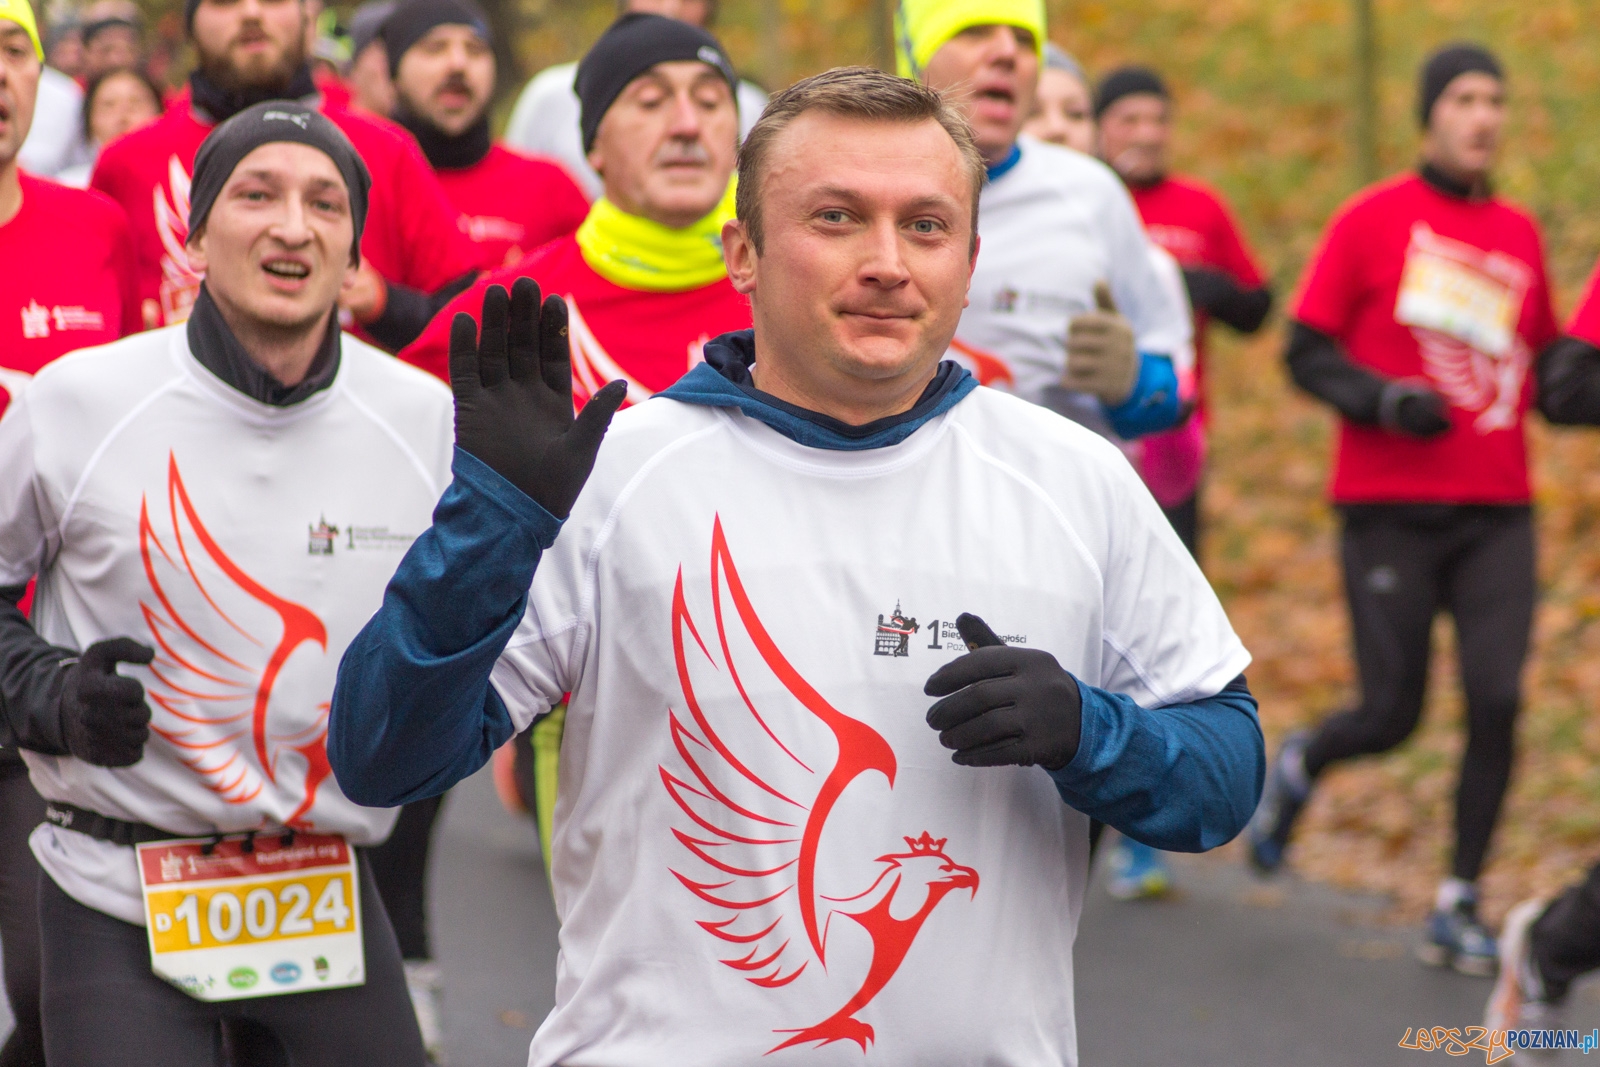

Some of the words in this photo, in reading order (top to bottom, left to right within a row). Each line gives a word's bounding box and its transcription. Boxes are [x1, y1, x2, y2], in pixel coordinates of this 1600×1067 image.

[927, 619, 943, 650] 1
[154, 913, 172, 933] D
[174, 878, 350, 945] 10024
